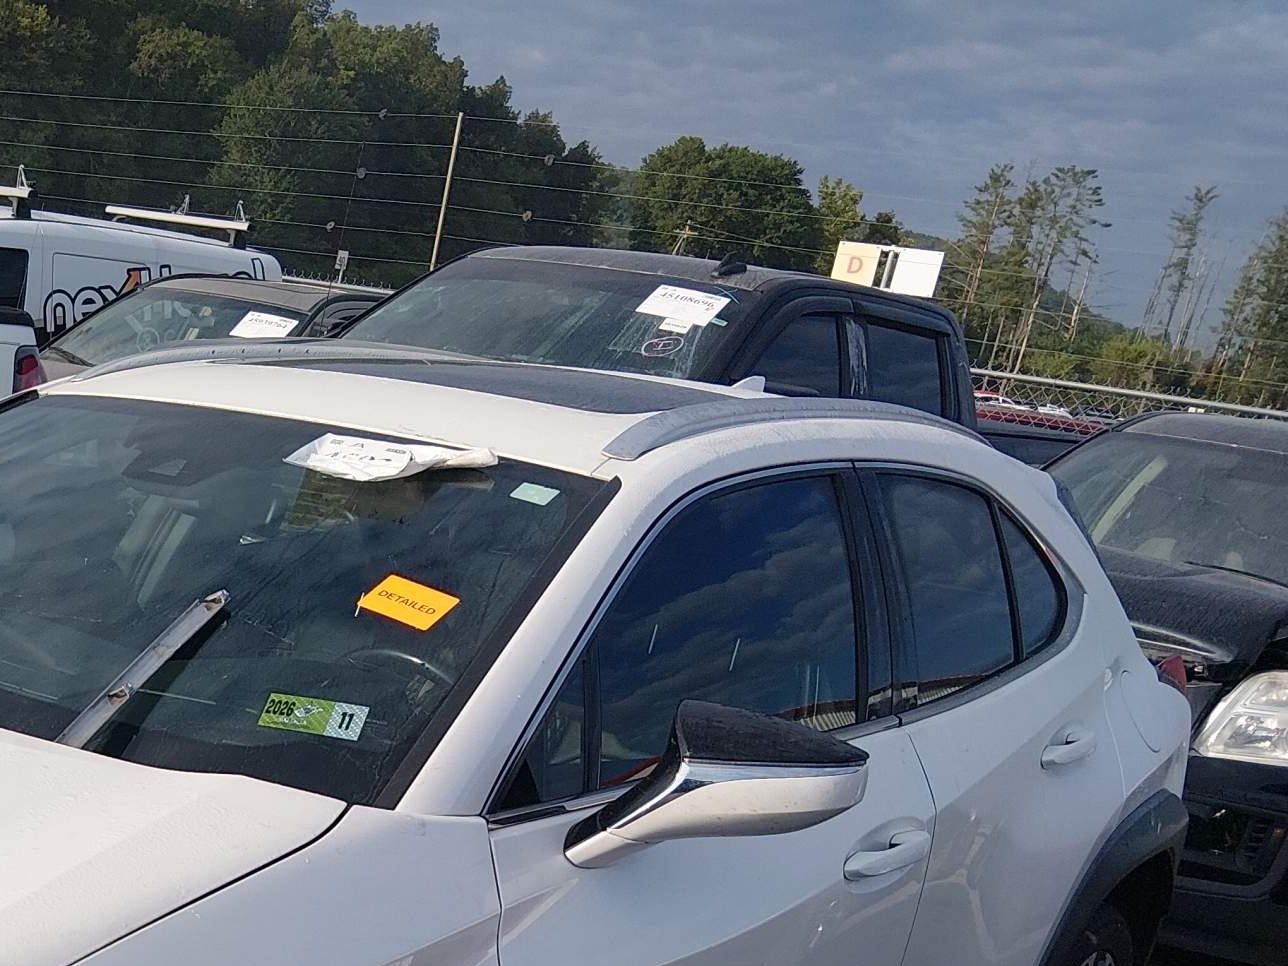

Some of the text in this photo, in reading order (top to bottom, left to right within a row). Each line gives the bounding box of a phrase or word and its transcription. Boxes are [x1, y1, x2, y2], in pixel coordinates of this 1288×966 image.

[846, 256, 863, 274] D
[377, 589, 437, 615] DETAILED
[265, 698, 296, 717] 2026
[337, 711, 355, 731] 11
